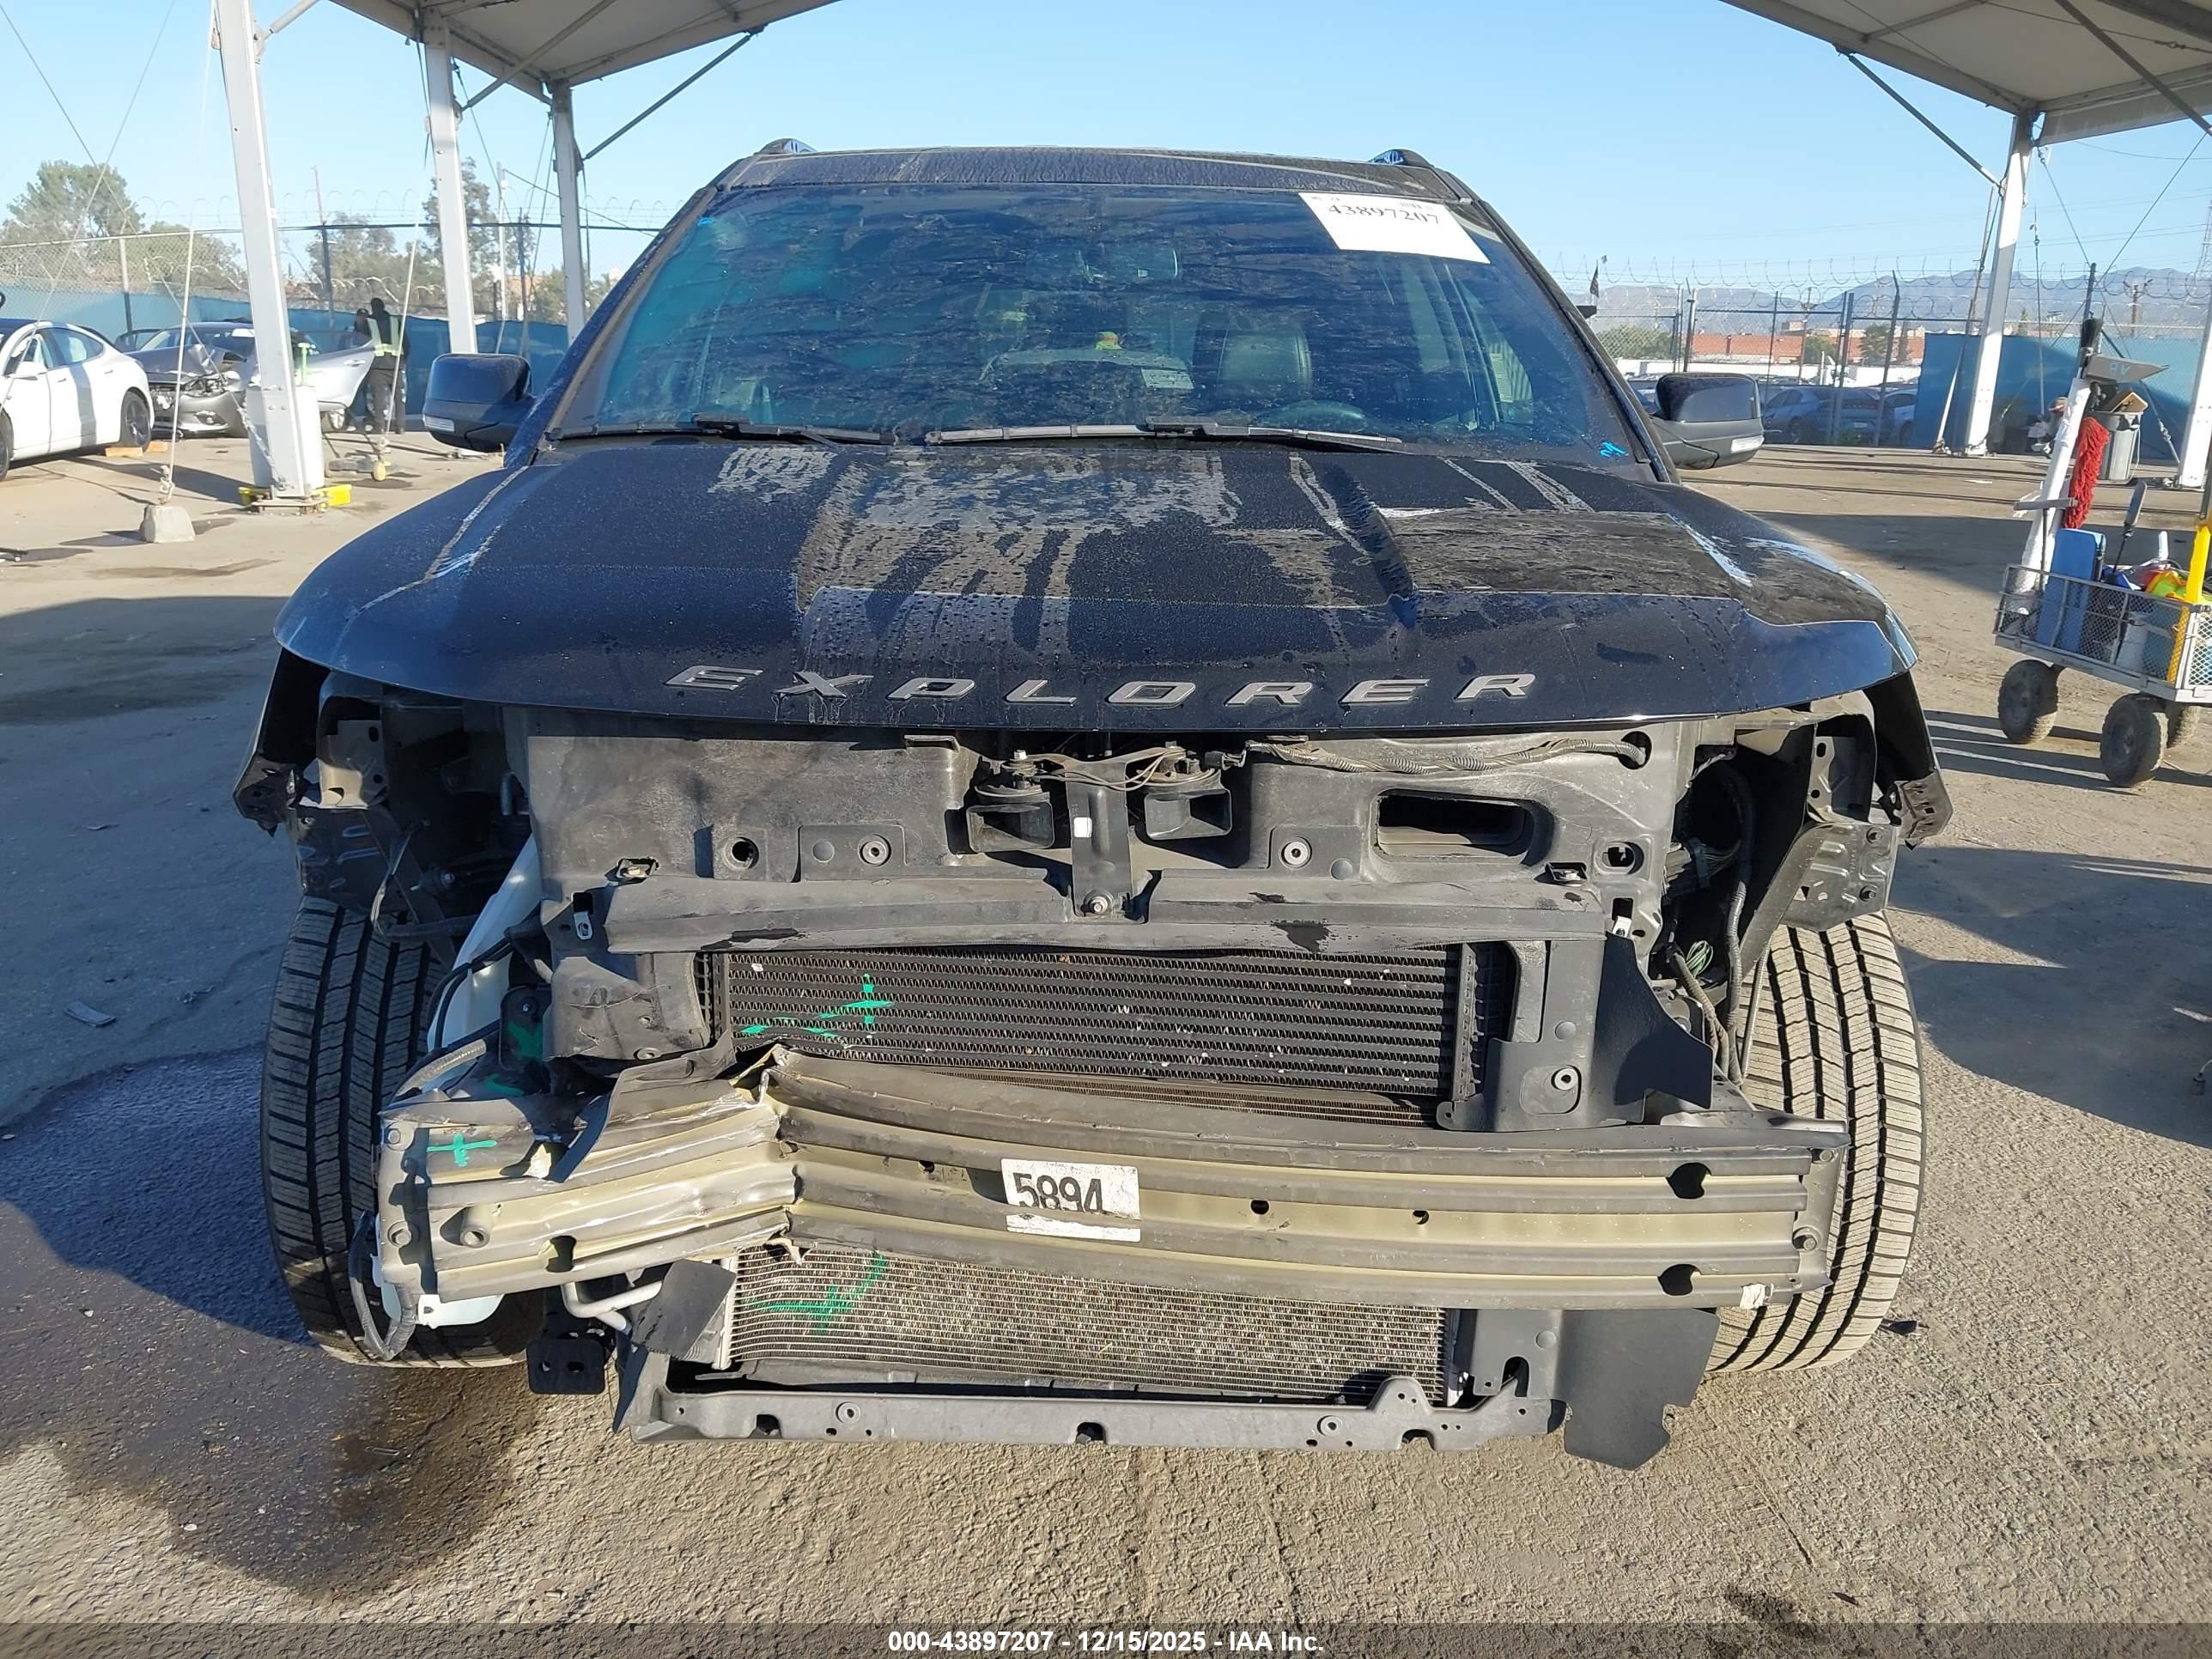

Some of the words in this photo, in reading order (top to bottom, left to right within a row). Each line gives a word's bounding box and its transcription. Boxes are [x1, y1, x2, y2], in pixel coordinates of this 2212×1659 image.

[1328, 204, 1439, 225] 43897207
[664, 665, 1536, 708] EXPLORER
[1012, 1172, 1103, 1212] 5894
